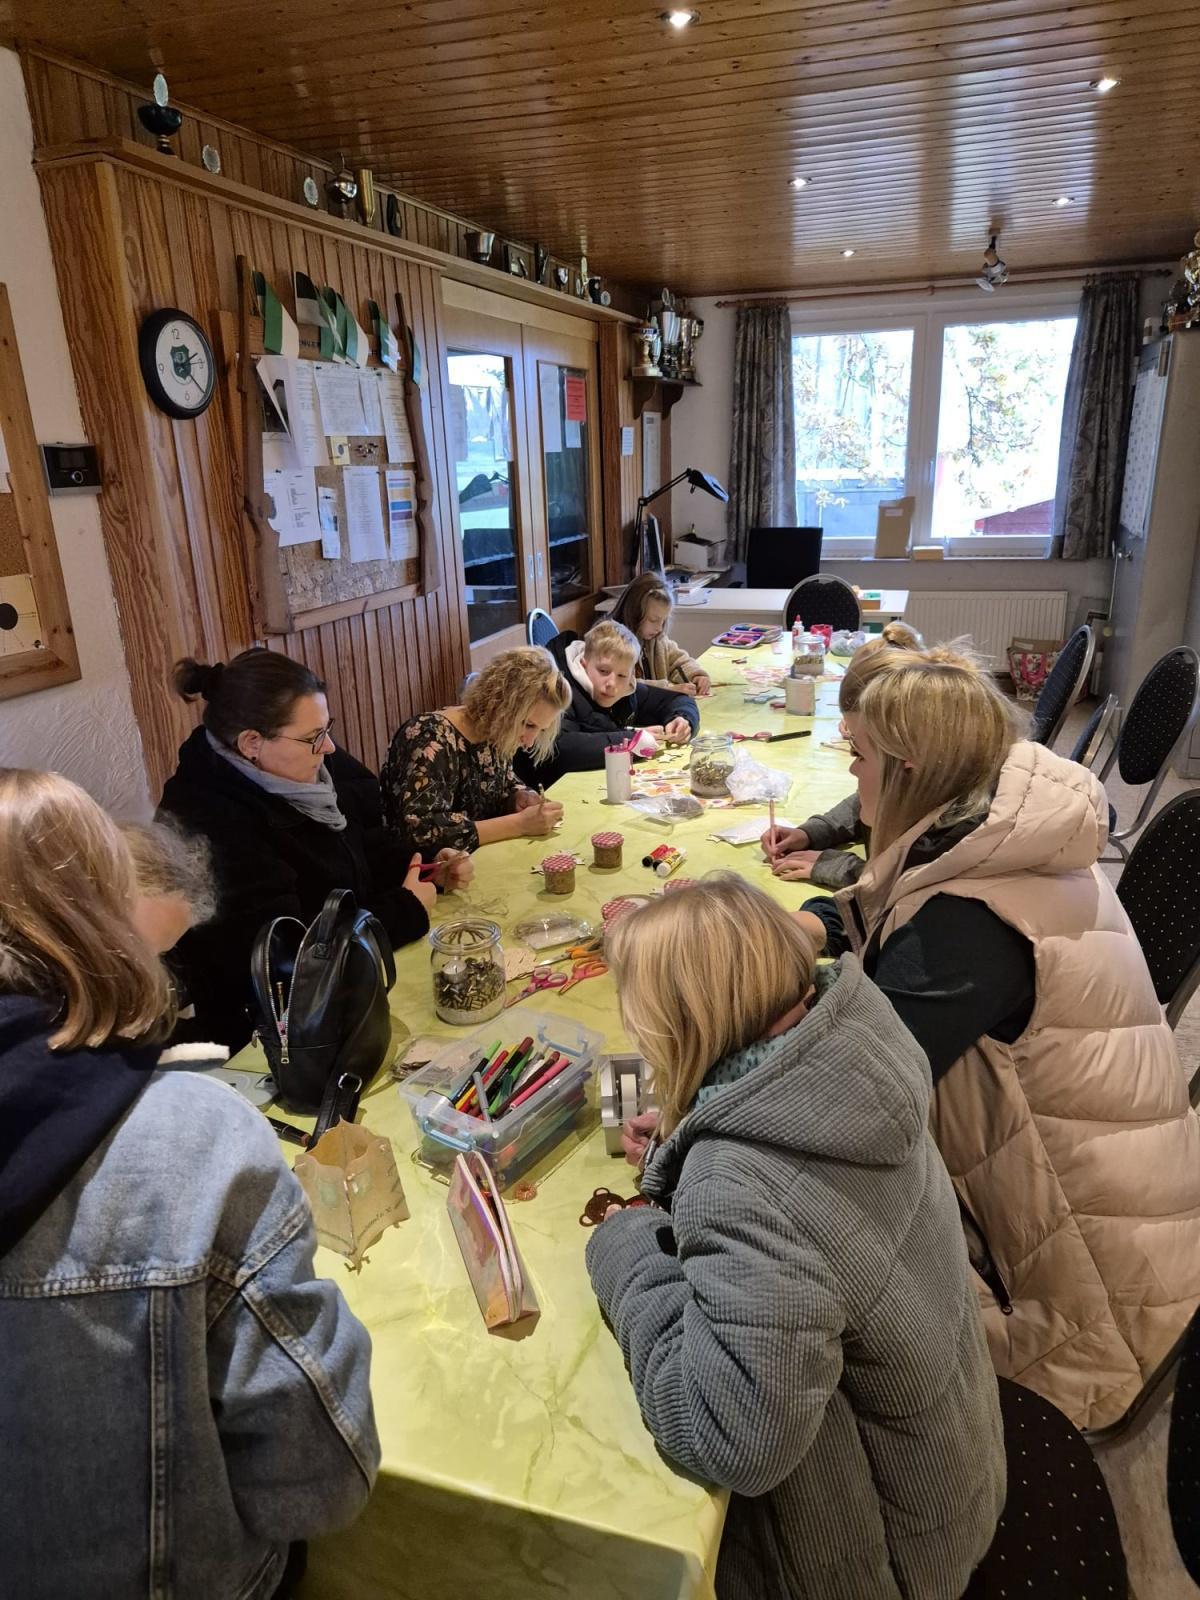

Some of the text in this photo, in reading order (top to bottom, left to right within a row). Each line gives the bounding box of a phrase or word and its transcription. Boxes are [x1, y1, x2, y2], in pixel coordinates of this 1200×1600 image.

[171, 328, 181, 340] 12
[158, 363, 165, 375] 9
[184, 391, 191, 402] 6
